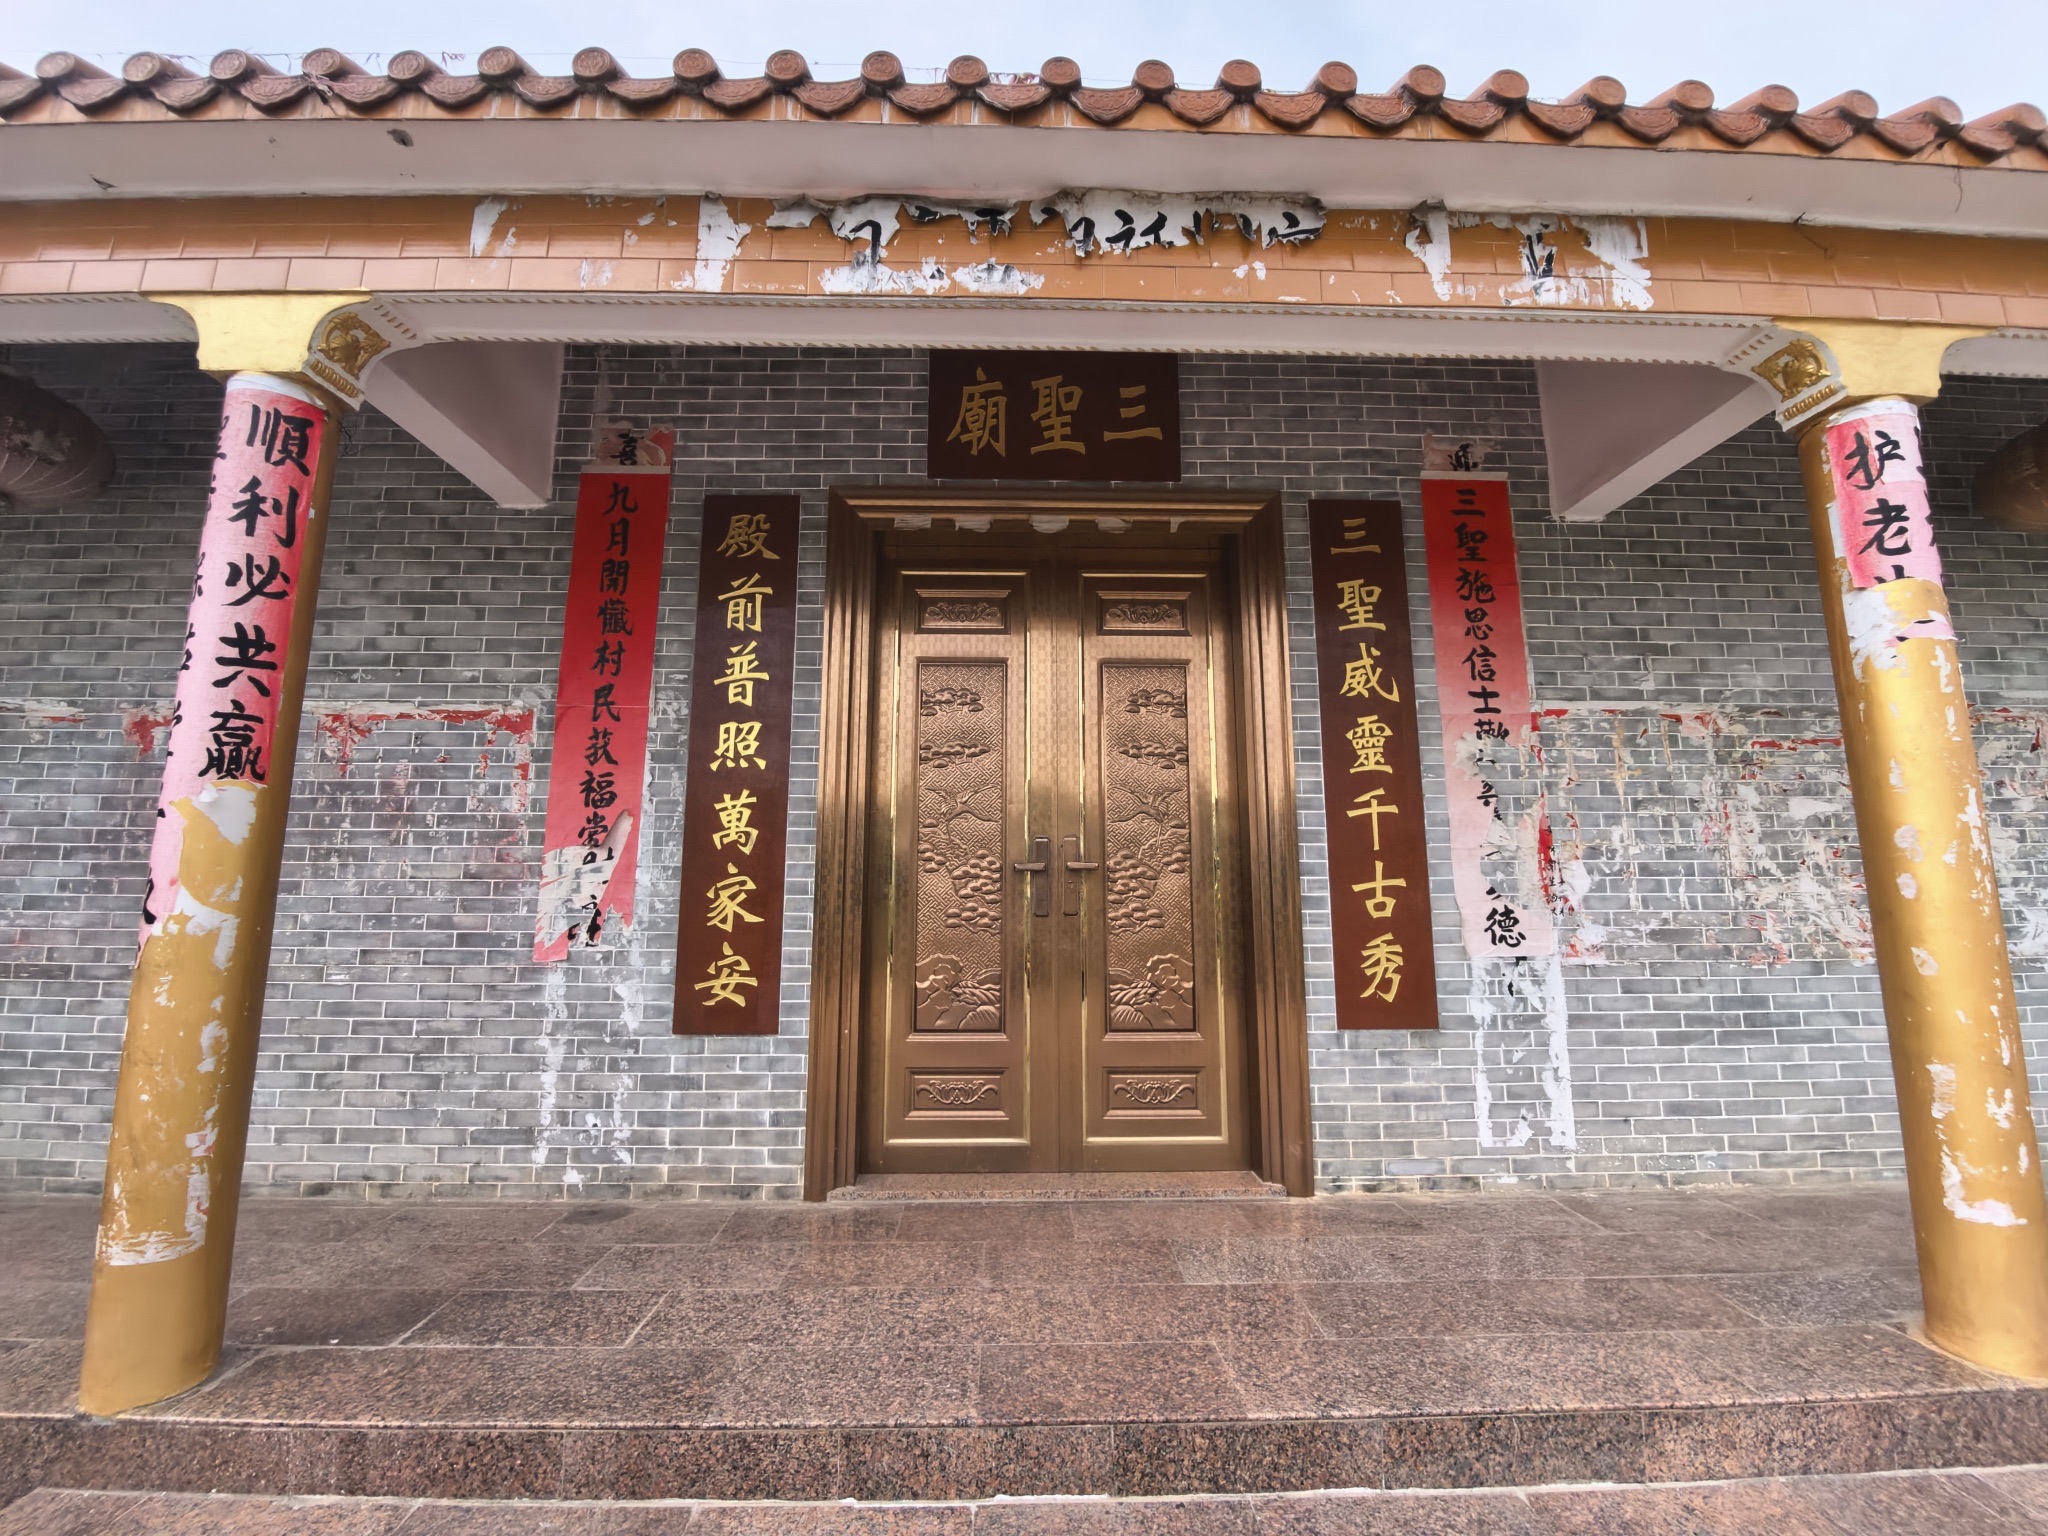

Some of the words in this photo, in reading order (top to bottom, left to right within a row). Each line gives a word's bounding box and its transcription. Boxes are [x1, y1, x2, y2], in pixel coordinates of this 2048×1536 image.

[694, 514, 781, 1007] 殿前普照萬家安
[1330, 517, 1407, 1003] 三聖威靈千古秀
